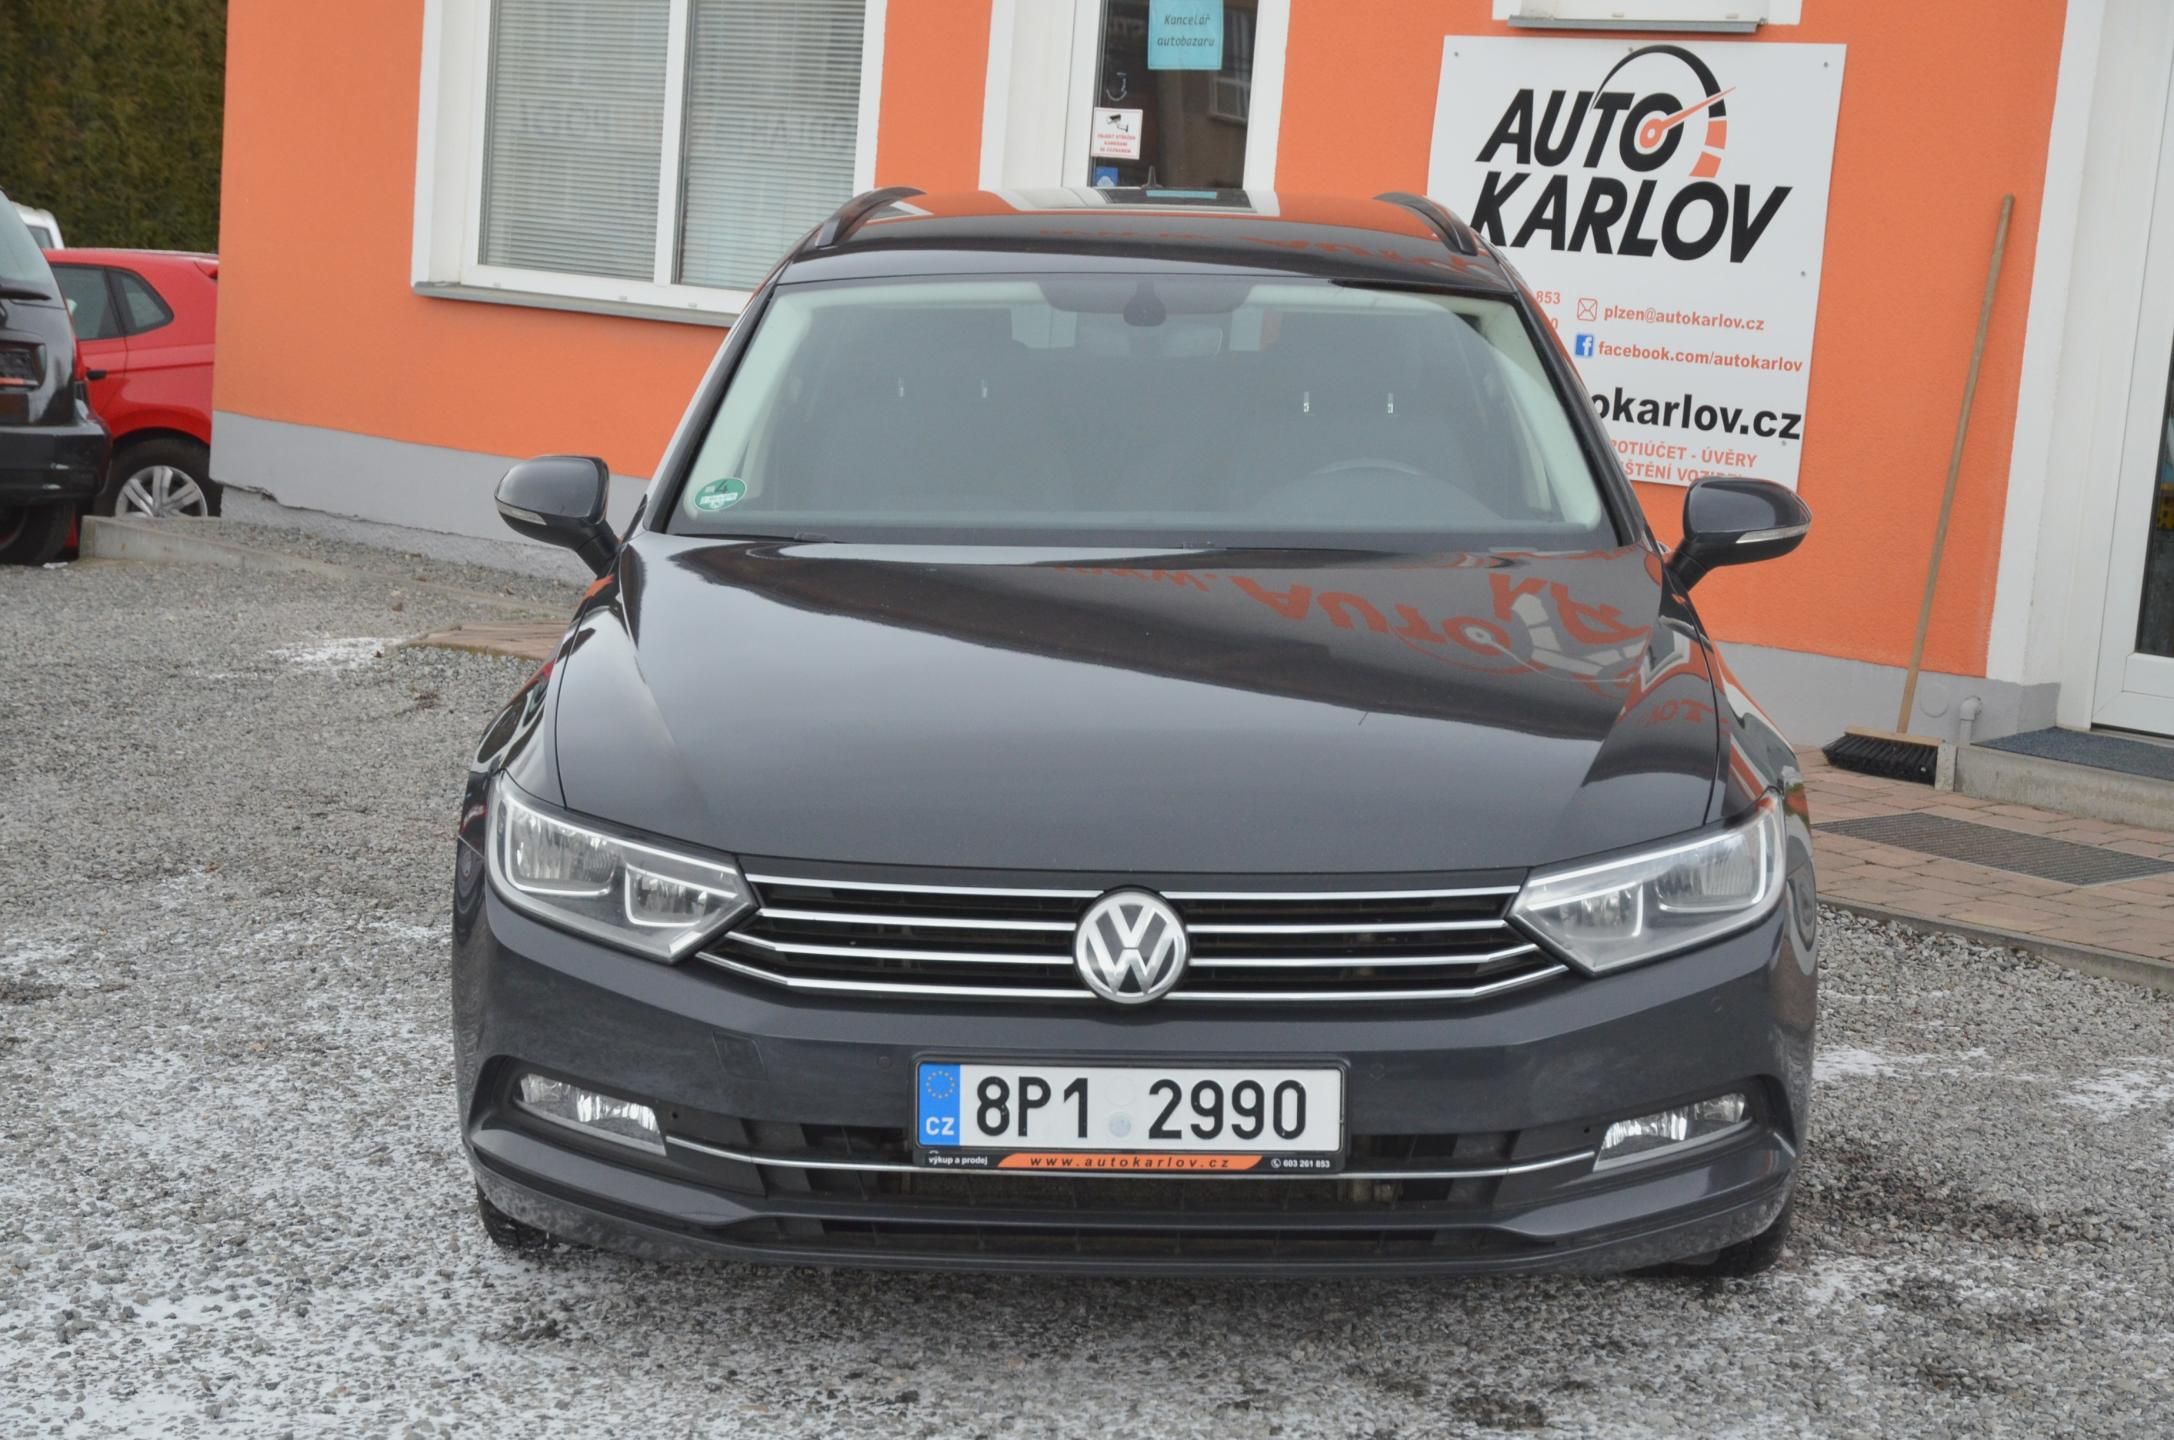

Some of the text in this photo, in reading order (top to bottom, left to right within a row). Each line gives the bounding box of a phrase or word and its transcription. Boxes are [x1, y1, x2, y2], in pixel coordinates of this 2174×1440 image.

[1157, 35, 1215, 47] autobazaru
[1475, 88, 1685, 172] AUTO
[1470, 170, 1793, 264] KARLOV
[1603, 305, 1765, 331] plzen@autokarlov.cz
[1598, 341, 1803, 372] facebook.com/autokarlov
[1619, 458, 1672, 480] ŠTĚNÍ
[1702, 446, 1758, 468] ÚVĚRY
[976, 1076, 1307, 1140] 8P1 2990
[925, 1116, 955, 1135] CZ
[961, 1155, 988, 1166] prodej
[1030, 1156, 1230, 1168] www.autokarlov.cz
